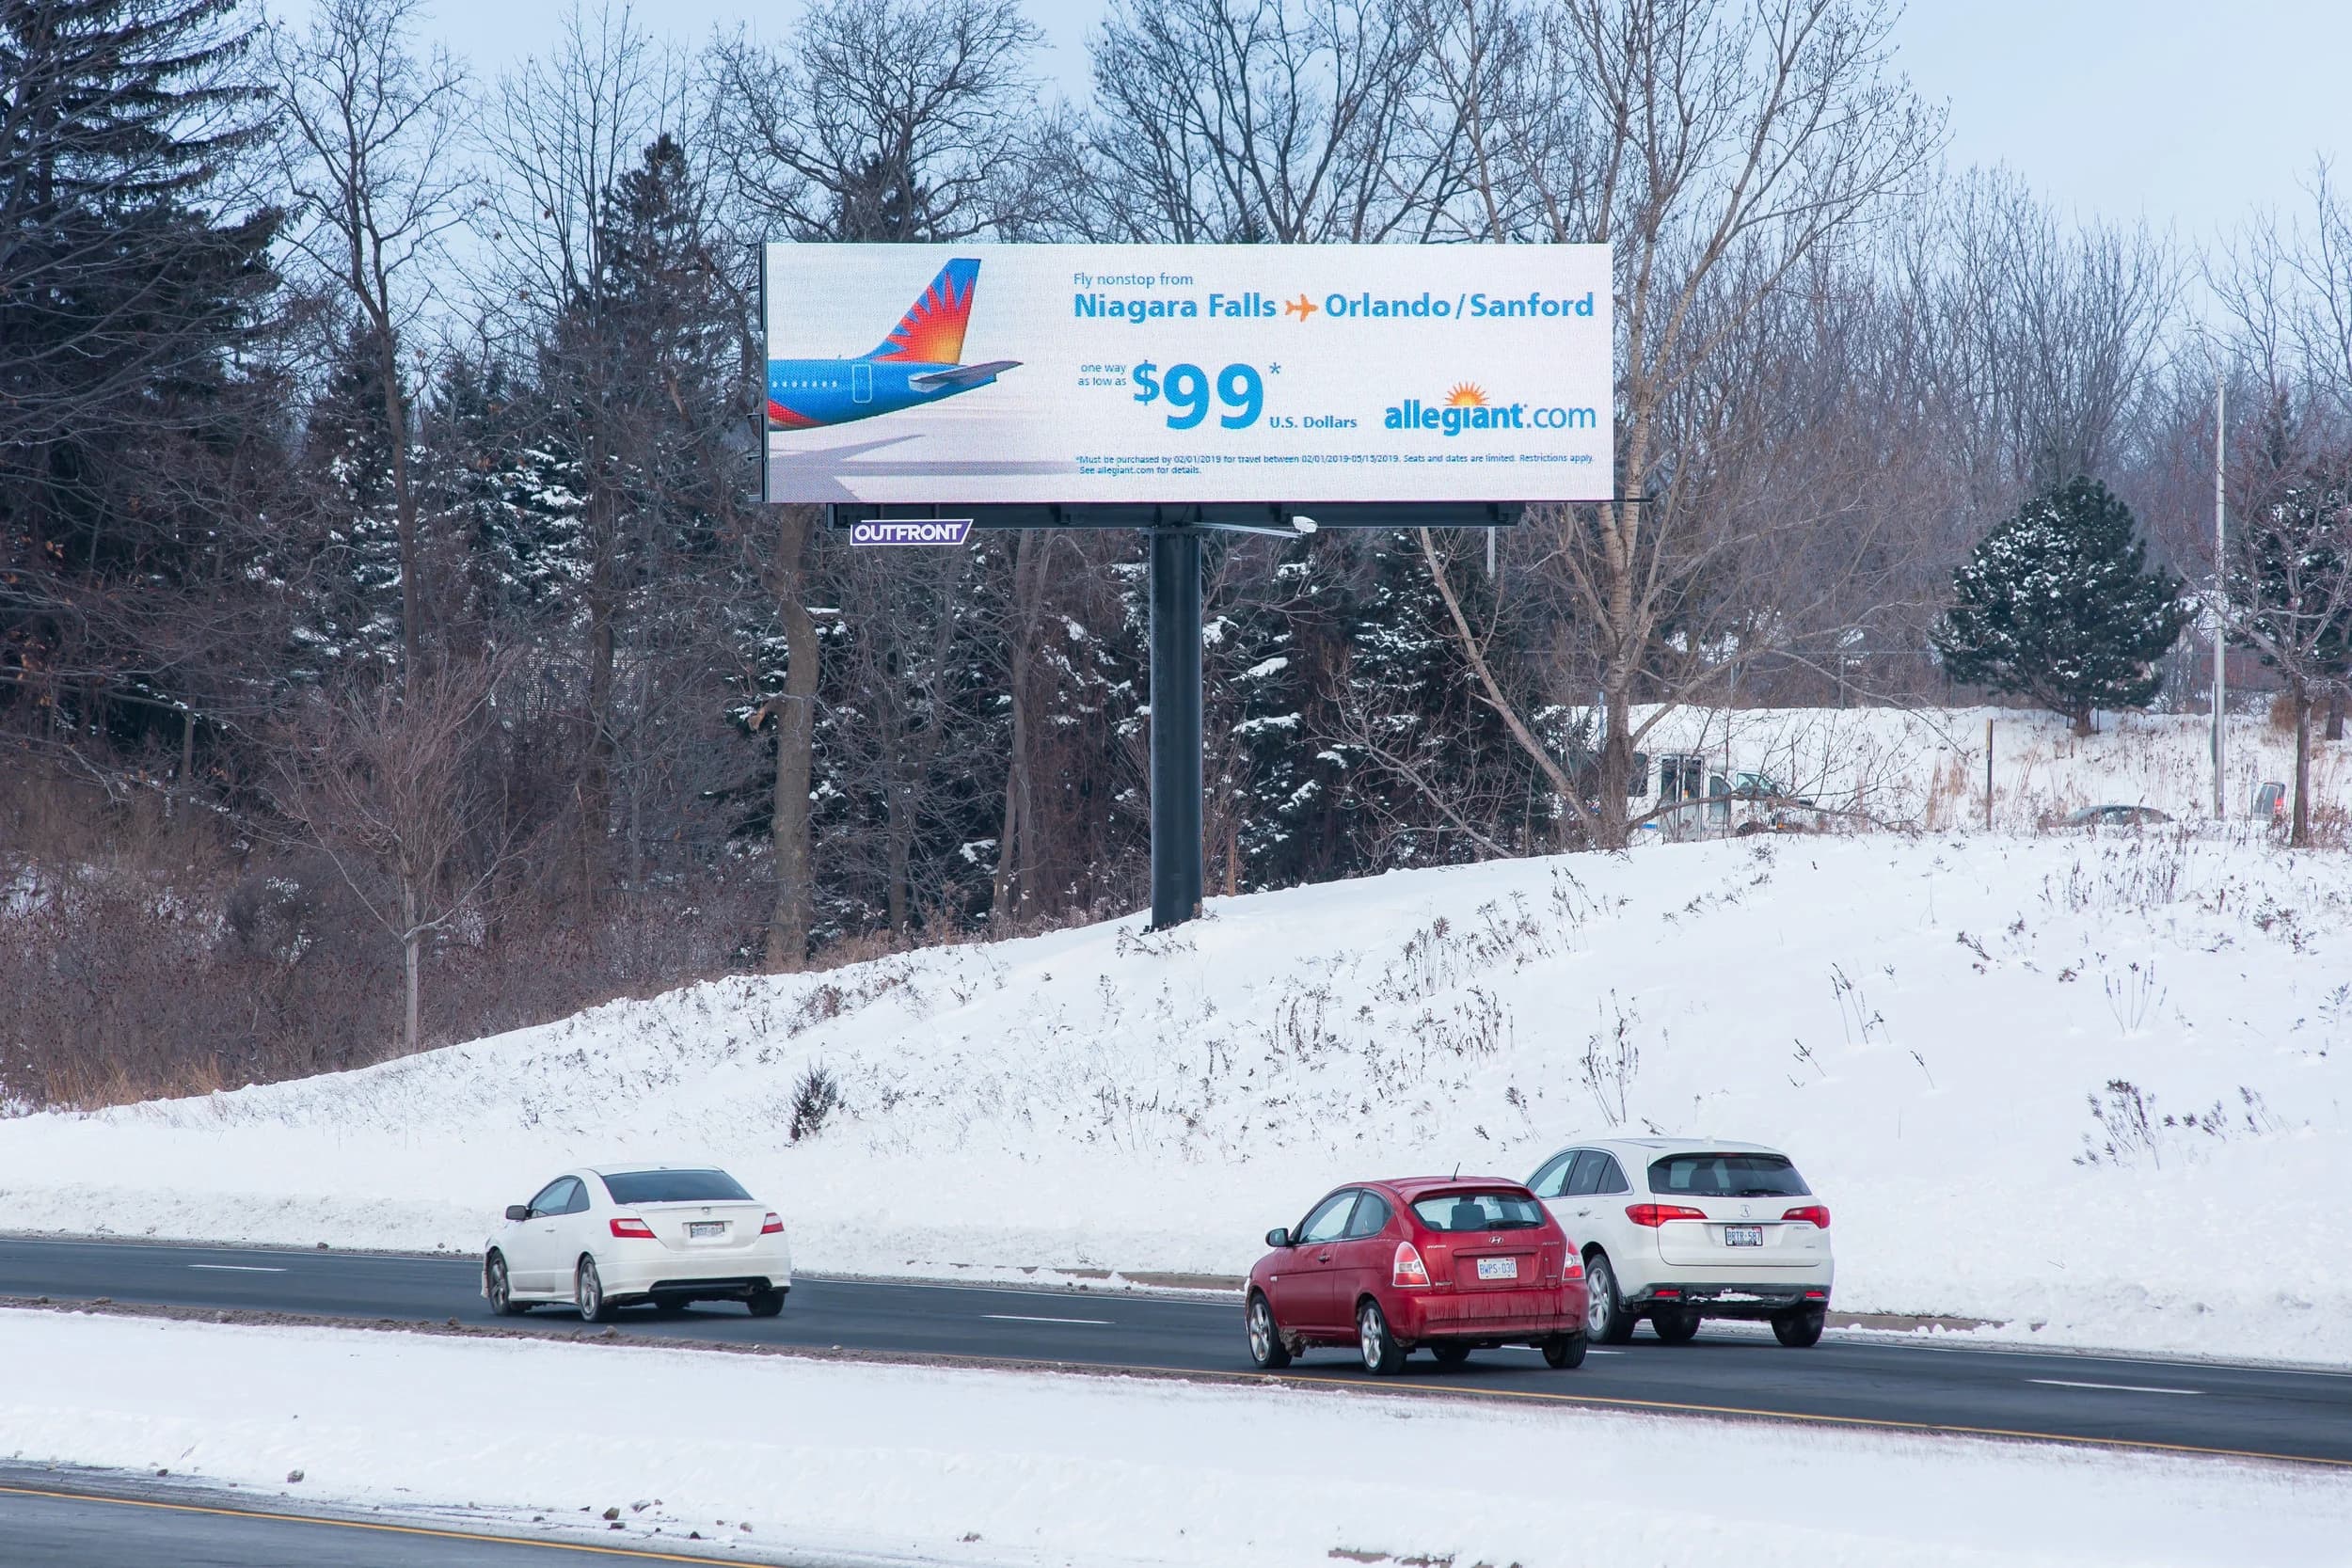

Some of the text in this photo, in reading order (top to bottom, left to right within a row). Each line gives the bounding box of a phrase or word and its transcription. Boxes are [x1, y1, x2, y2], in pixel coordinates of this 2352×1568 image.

[1073, 272, 1193, 289] Fly nonstop from
[1074, 293, 1198, 324] Niagara
[1209, 293, 1277, 317] Falls
[1081, 364, 1126, 375] one way
[1077, 376, 1127, 386] as low as
[1270, 416, 1358, 428] U.S. Dollars
[1104, 455, 1114, 464] be
[1117, 455, 1159, 466] purchased
[1162, 456, 1171, 466] by
[1224, 455, 1235, 464] for
[1237, 455, 1261, 464] travel
[1263, 455, 1299, 464] between
[1404, 454, 1425, 463] Seats
[1427, 453, 1443, 463] and
[1446, 453, 1468, 463] dates
[1470, 454, 1484, 463] are
[1519, 453, 1567, 462] Restrictions
[1079, 465, 1201, 477] See allegiant.com for details.
[854, 524, 962, 541] OUTFRONT
